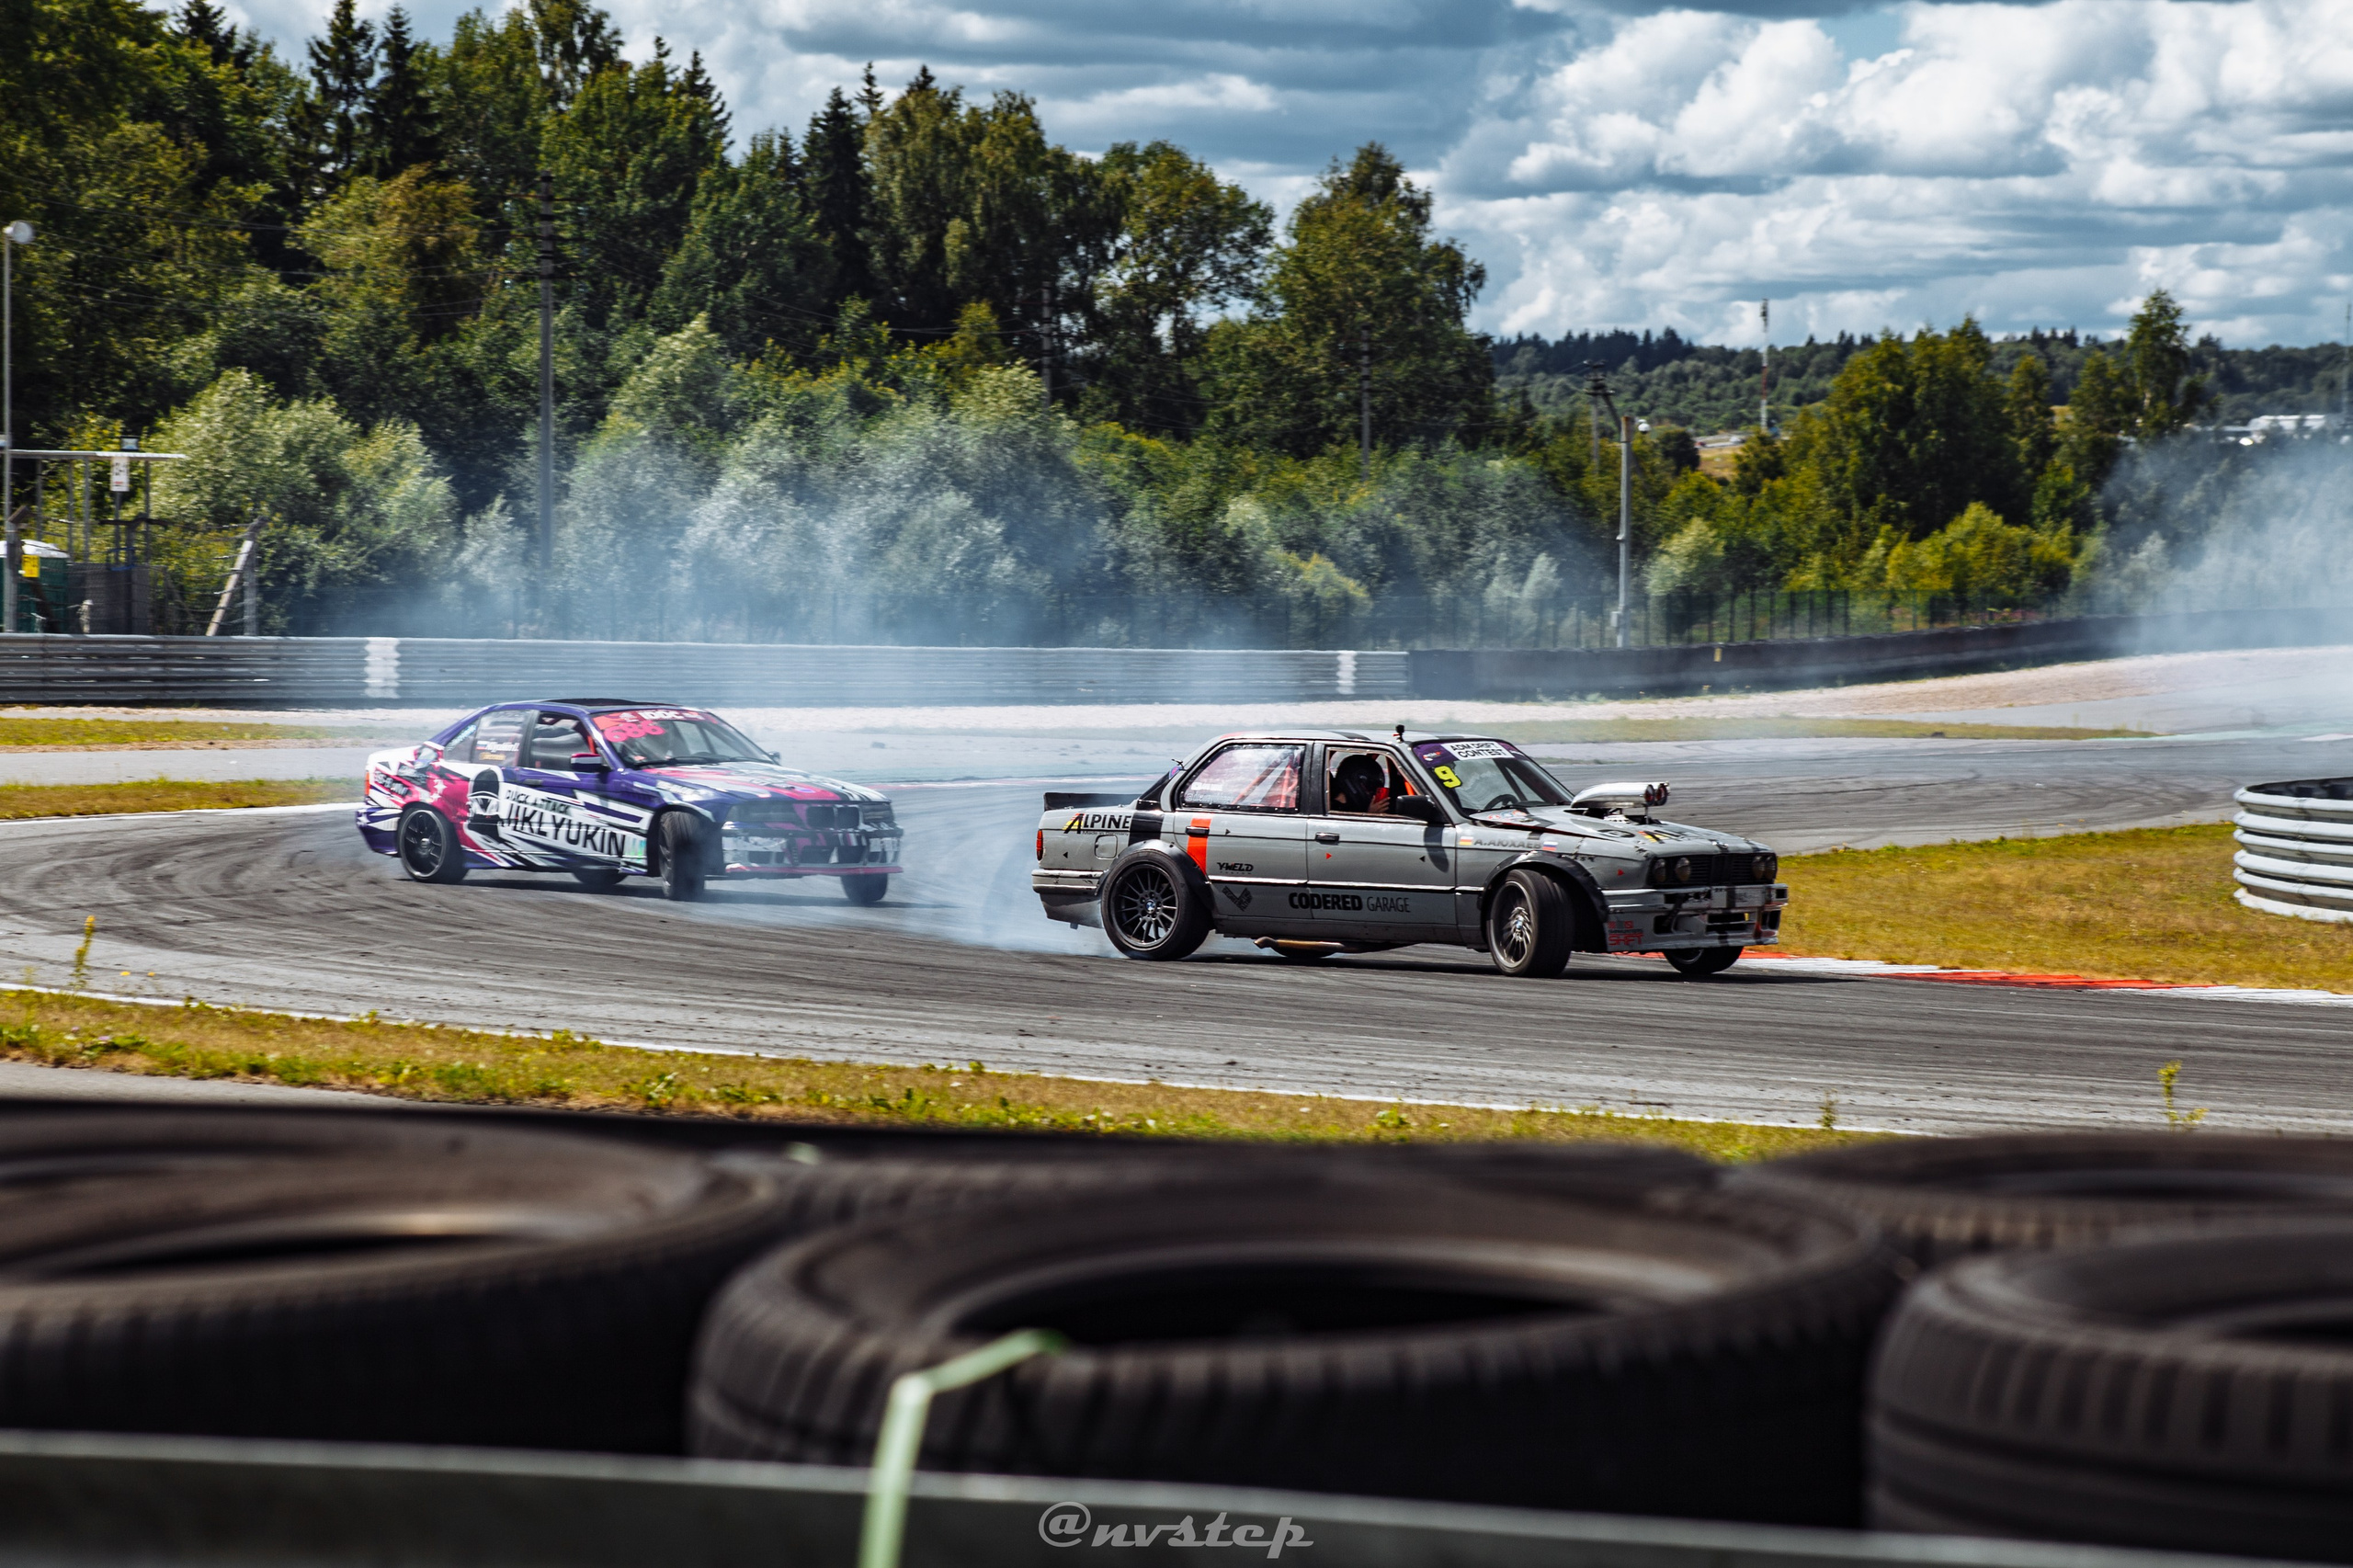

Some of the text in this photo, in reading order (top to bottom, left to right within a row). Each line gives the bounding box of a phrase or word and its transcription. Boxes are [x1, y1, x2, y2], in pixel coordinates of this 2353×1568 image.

[603, 720, 666, 743] 686
[1449, 742, 1498, 752] ADM DRIFT
[1457, 748, 1507, 758] CONTEST
[1434, 765, 1463, 789] 9
[1063, 812, 1132, 835] ALPINE
[1289, 892, 1411, 914] CODERED GARAGE
